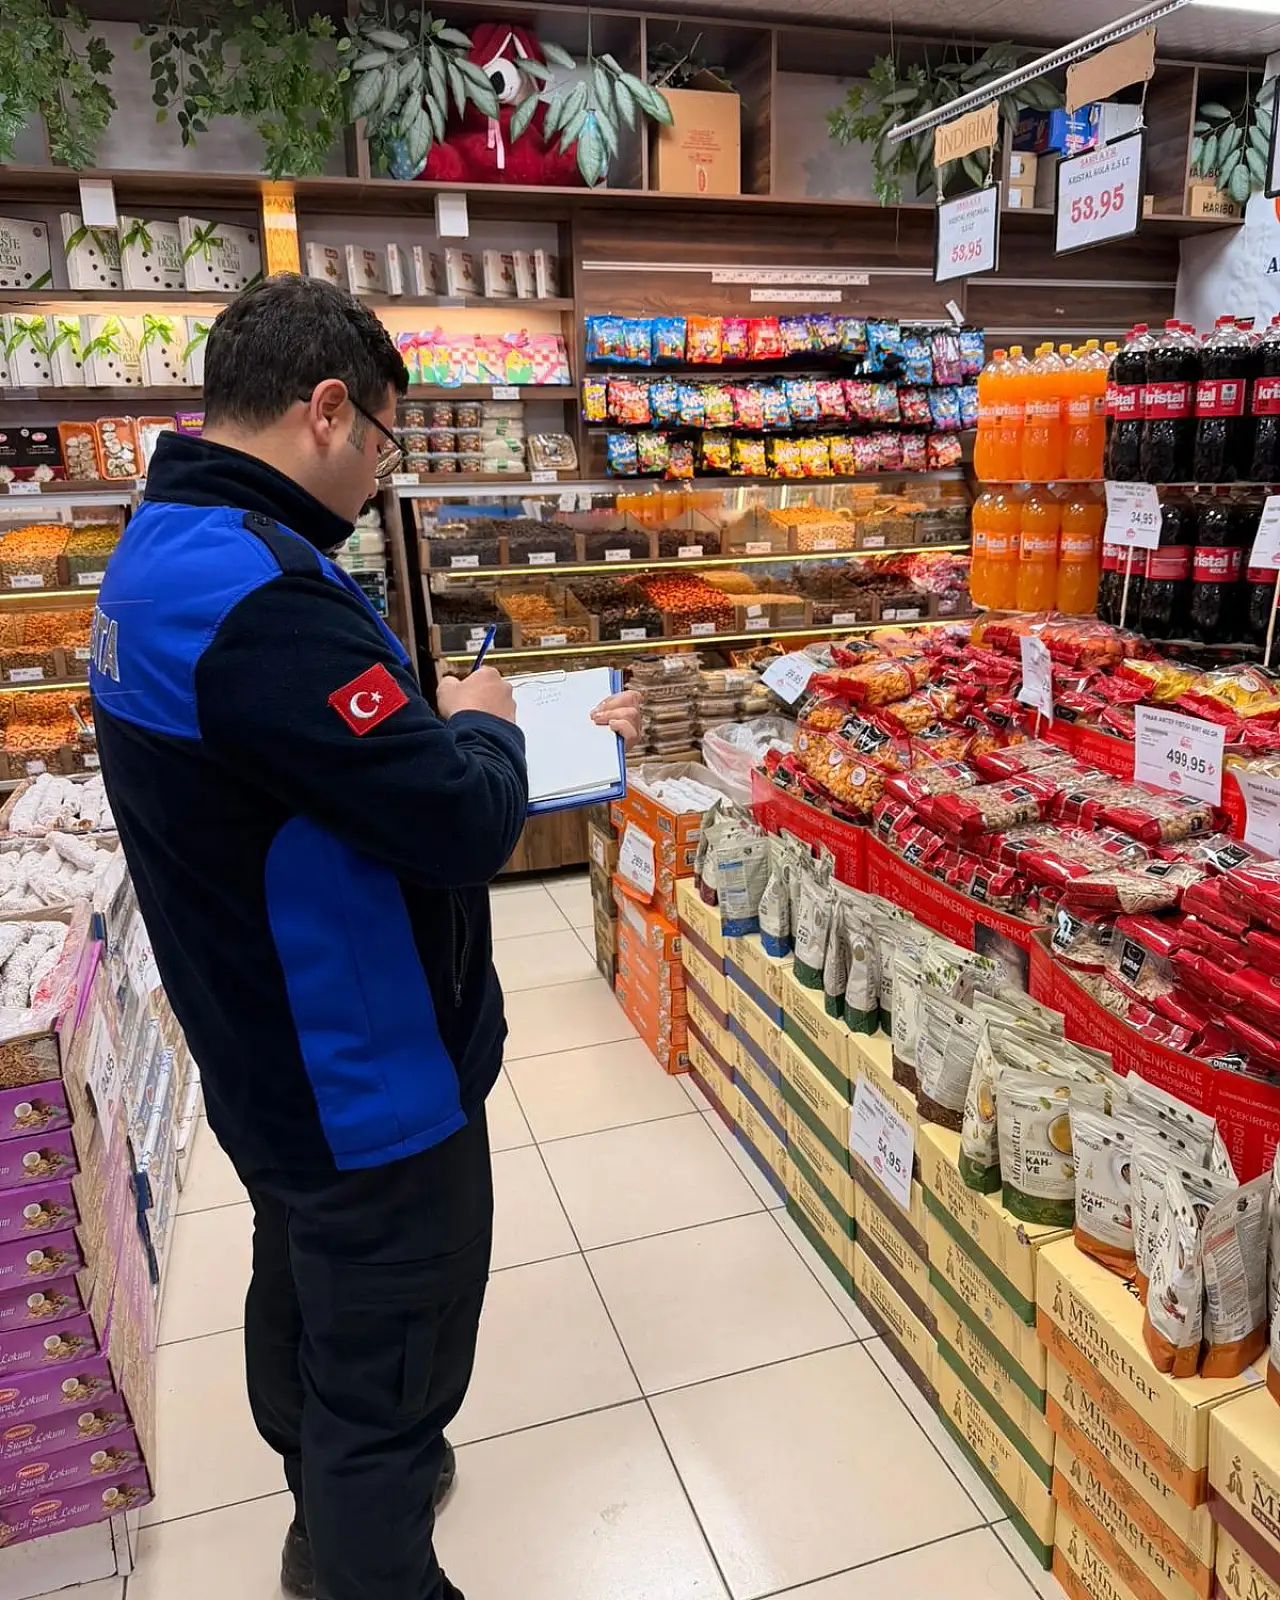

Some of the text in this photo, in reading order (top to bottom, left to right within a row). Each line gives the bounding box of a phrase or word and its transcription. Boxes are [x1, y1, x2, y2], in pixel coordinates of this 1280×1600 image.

[939, 114, 993, 154] İNDİRİM
[1070, 182, 1125, 224] 53,95
[1202, 201, 1234, 215] HARIBO
[1167, 748, 1206, 774] 499,95
[1068, 1301, 1156, 1402] Minnettar
[1080, 1391, 1171, 1498] Minnettar
[1088, 1470, 1176, 1579] Minnettar
